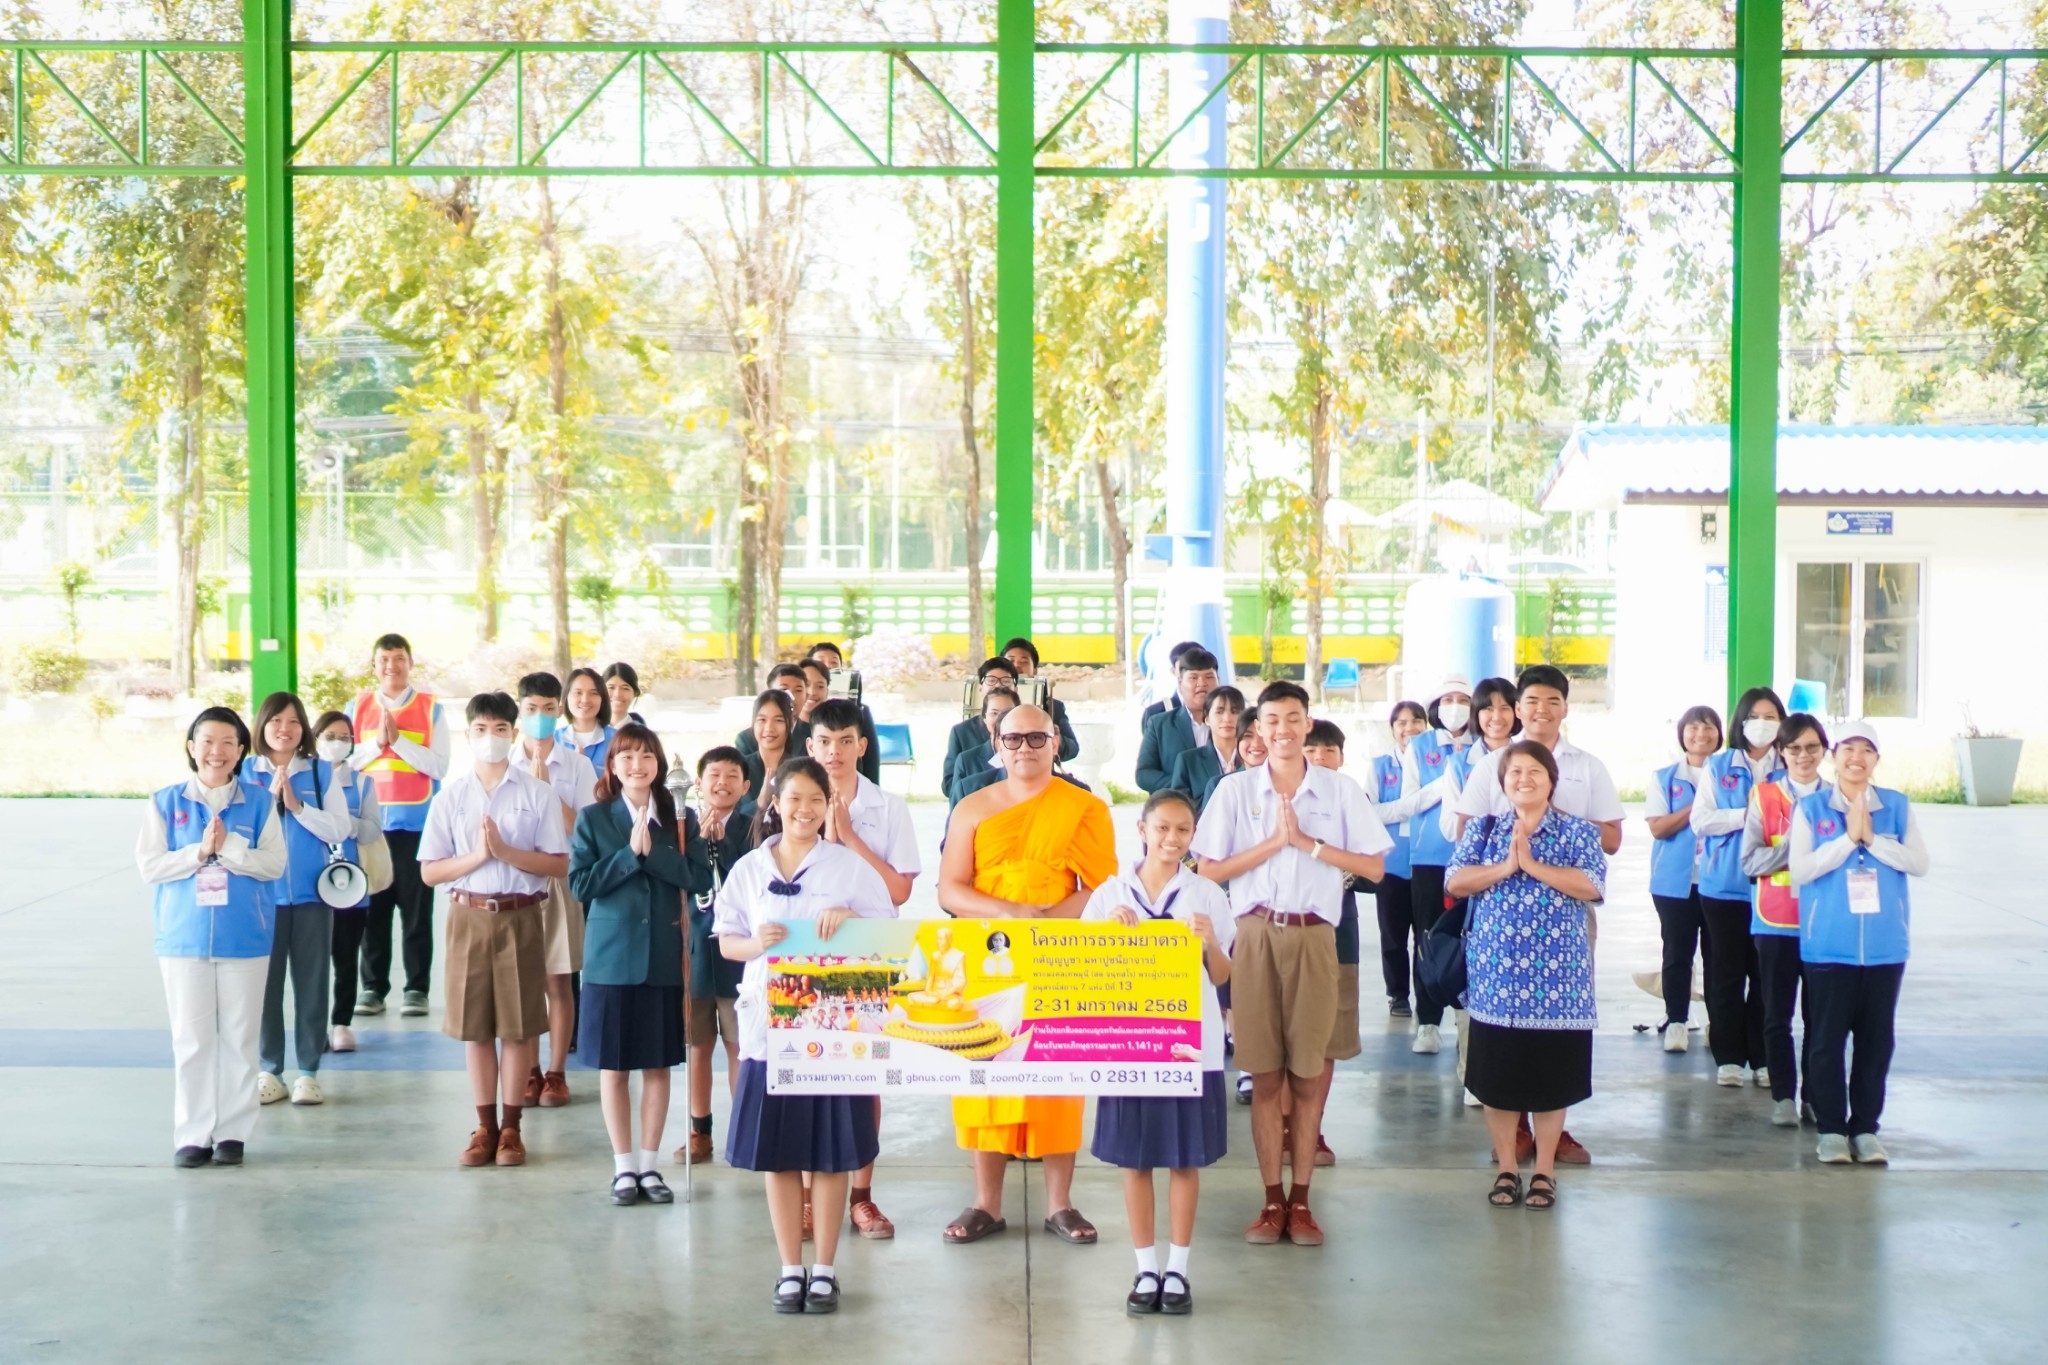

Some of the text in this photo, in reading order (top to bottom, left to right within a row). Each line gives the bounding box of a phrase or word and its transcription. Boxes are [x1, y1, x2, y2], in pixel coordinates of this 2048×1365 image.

[1030, 926, 1189, 947] โครงการธรรมยาตรา
[1118, 981, 1133, 991] 13
[1033, 998, 1188, 1012] 2-31 มกราคม 2568
[905, 1073, 961, 1084] gbnus.com
[990, 1073, 1064, 1083] zoom072.com
[1090, 1070, 1101, 1083] 0
[1107, 1070, 1147, 1083] 2831
[1154, 1070, 1194, 1083] 1234
